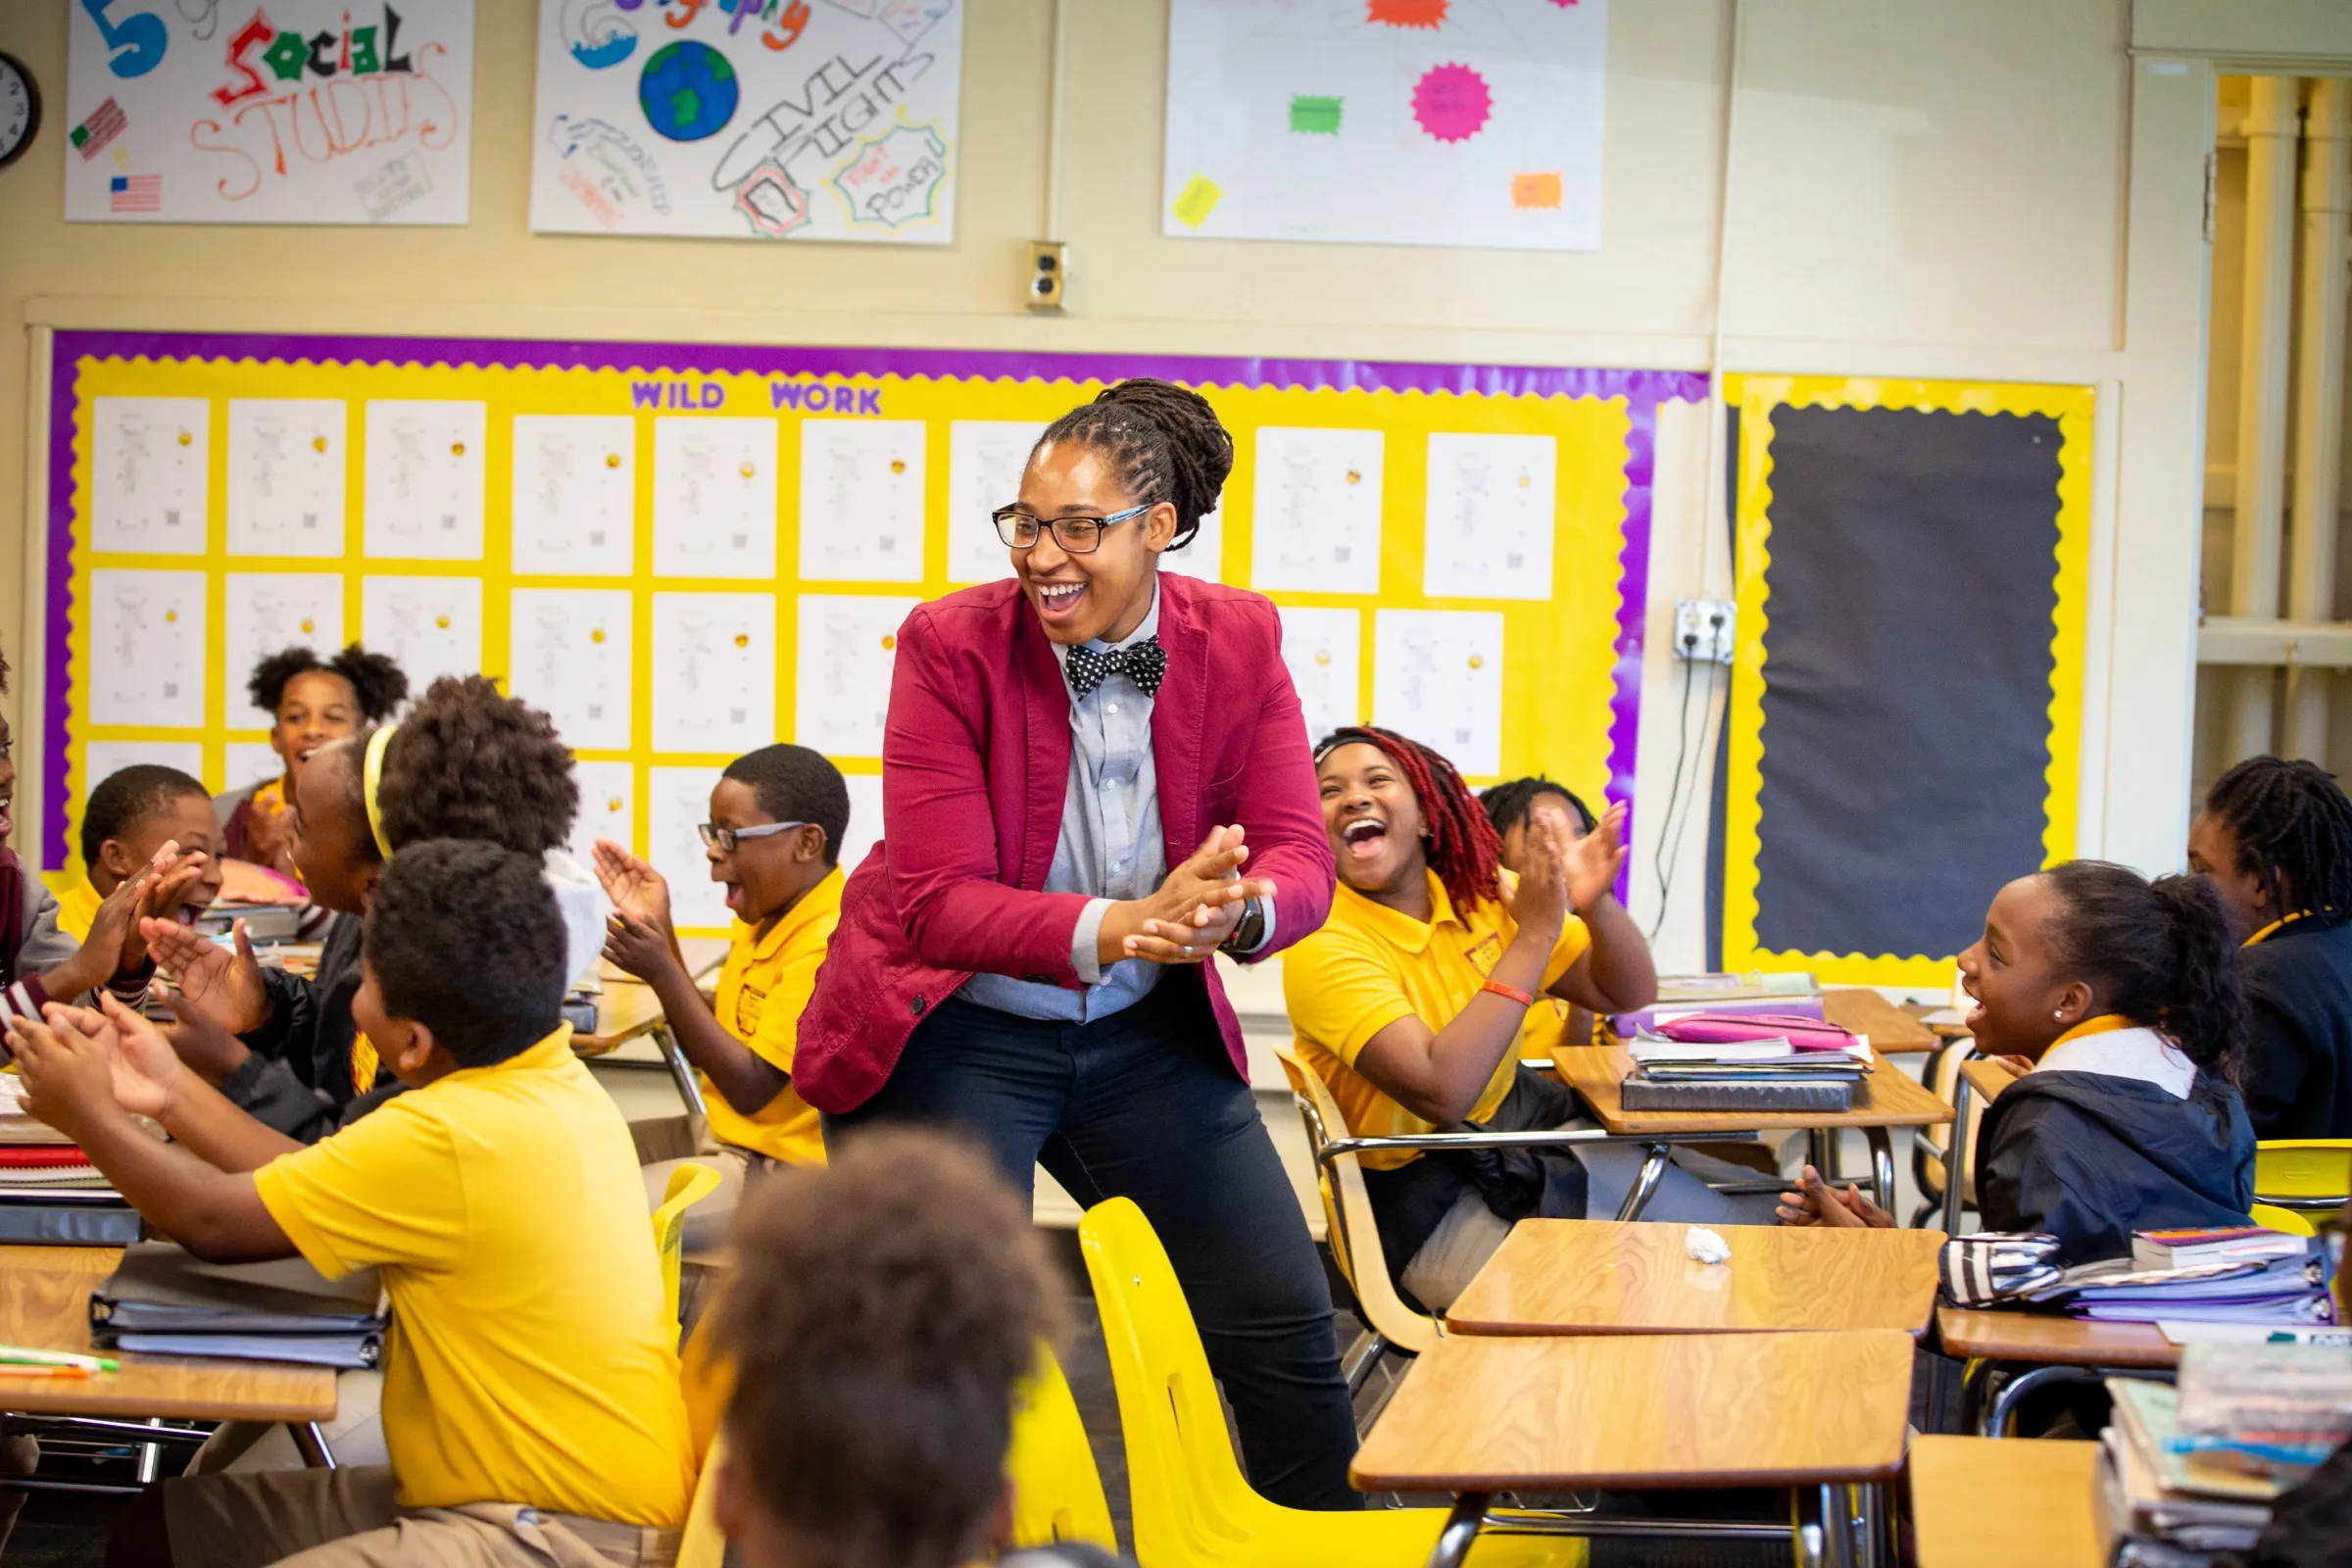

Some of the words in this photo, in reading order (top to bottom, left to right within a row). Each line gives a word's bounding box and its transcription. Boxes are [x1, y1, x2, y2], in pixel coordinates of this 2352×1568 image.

[711, 54, 884, 192] CIVIL
[631, 381, 726, 410] WILD
[769, 381, 882, 416] WORK
